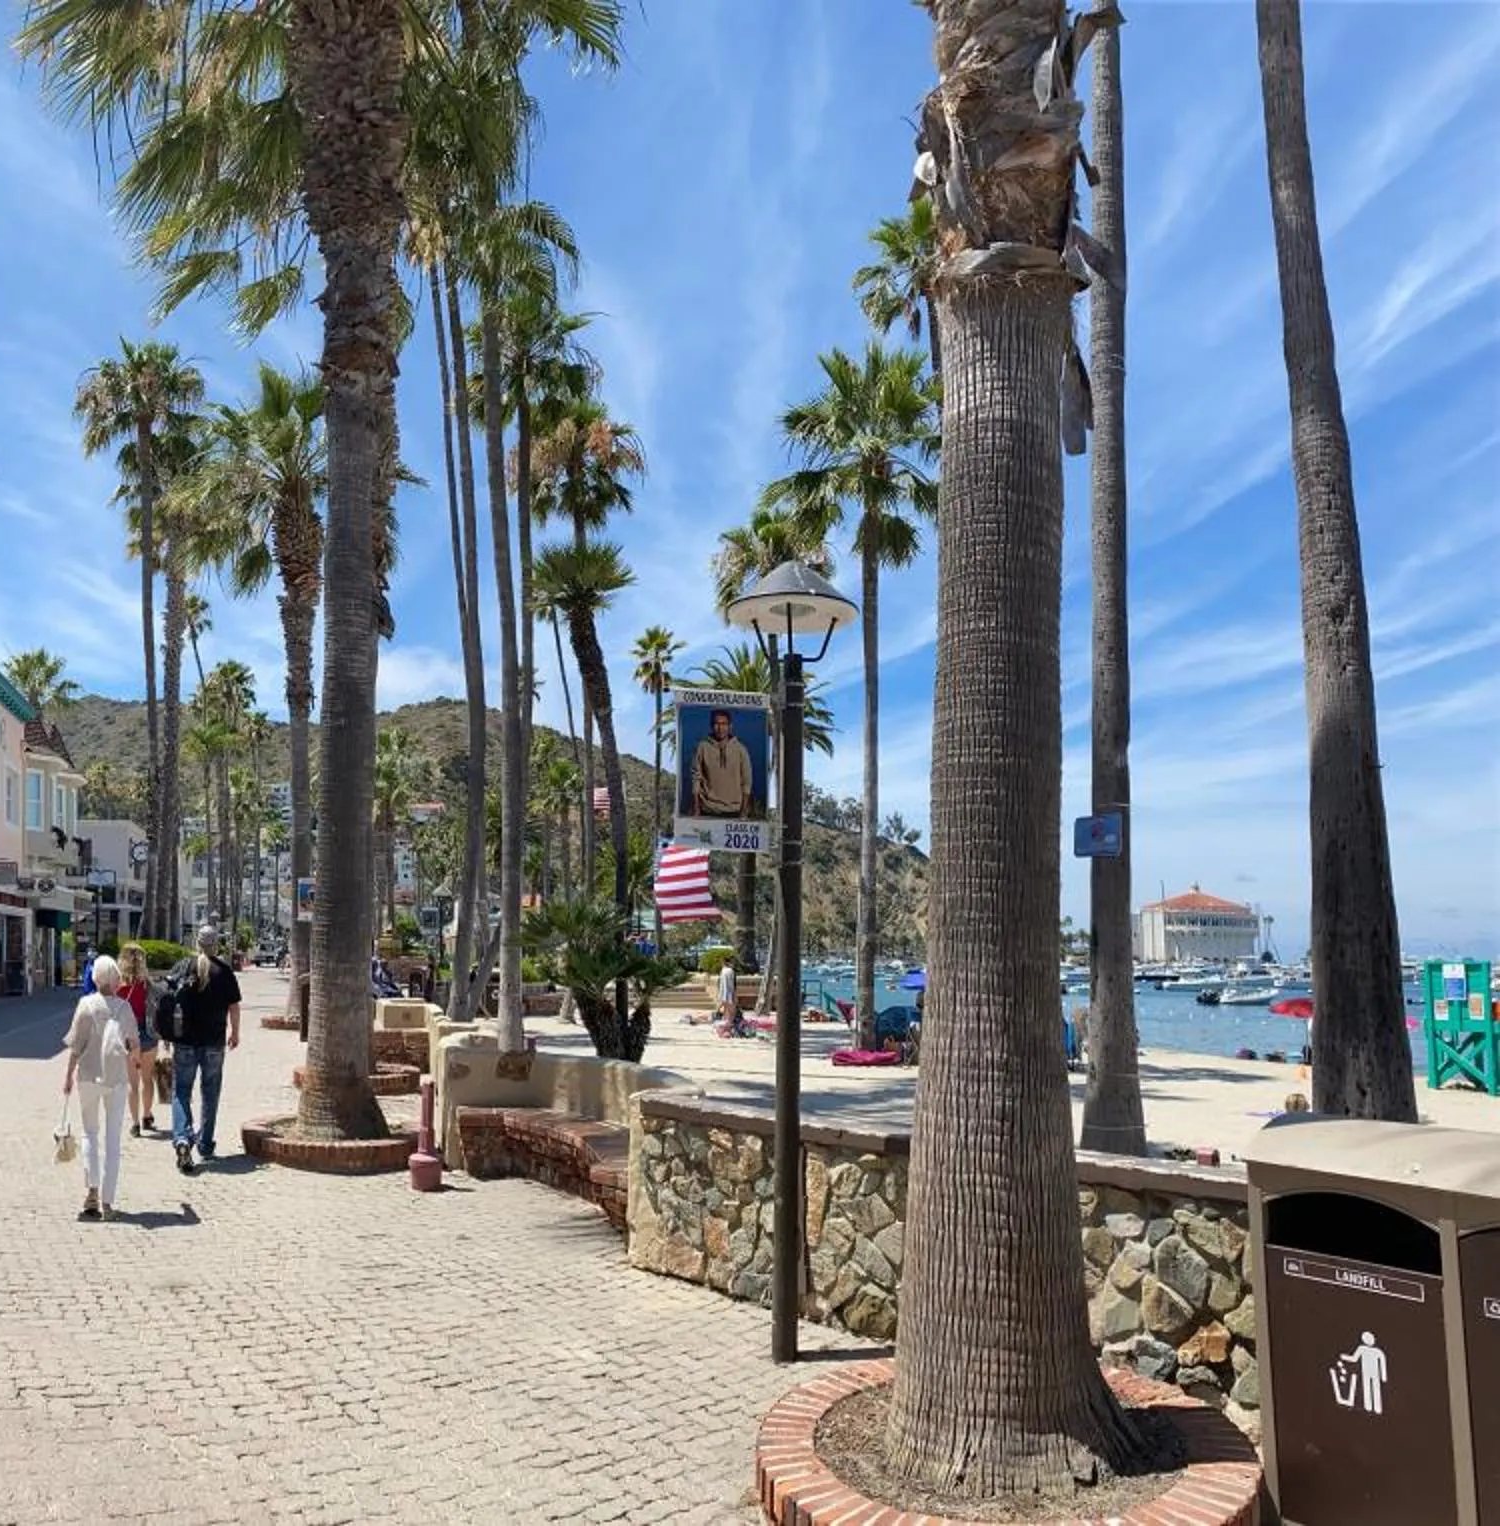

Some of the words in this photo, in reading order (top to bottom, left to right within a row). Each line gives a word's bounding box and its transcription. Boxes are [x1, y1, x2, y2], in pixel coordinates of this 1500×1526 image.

[683, 691, 763, 706] CONGRATULATIONS
[725, 823, 748, 834] CLASS
[750, 824, 760, 834] OF
[725, 833, 760, 849] 2020
[1335, 1268, 1387, 1292] LANDFILL
